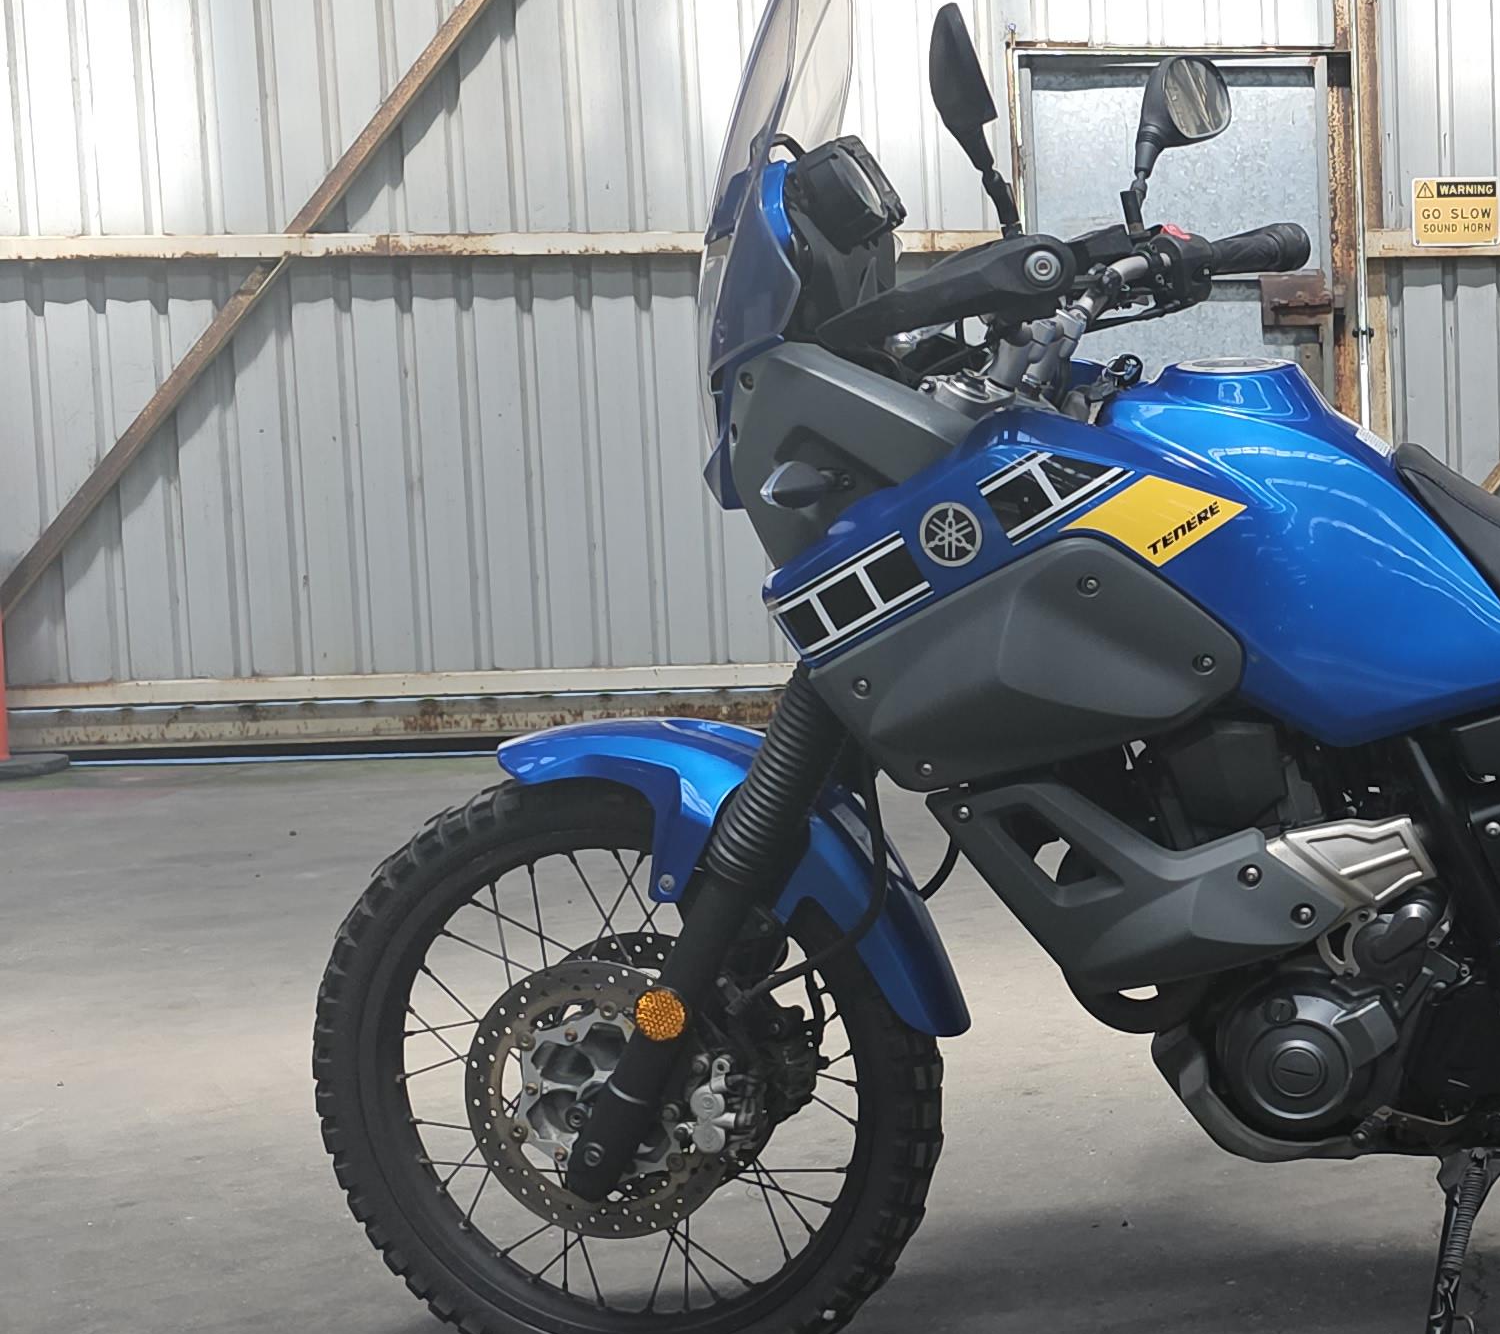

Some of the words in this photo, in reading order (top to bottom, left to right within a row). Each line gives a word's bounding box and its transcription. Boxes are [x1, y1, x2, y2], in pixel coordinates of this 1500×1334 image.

[1439, 184, 1494, 196] WARNING
[1422, 209, 1441, 220] GO
[1450, 208, 1492, 219] SLOW
[1423, 224, 1458, 233] SOUND
[1463, 223, 1492, 232] HORN
[1147, 501, 1221, 556] TENERE
